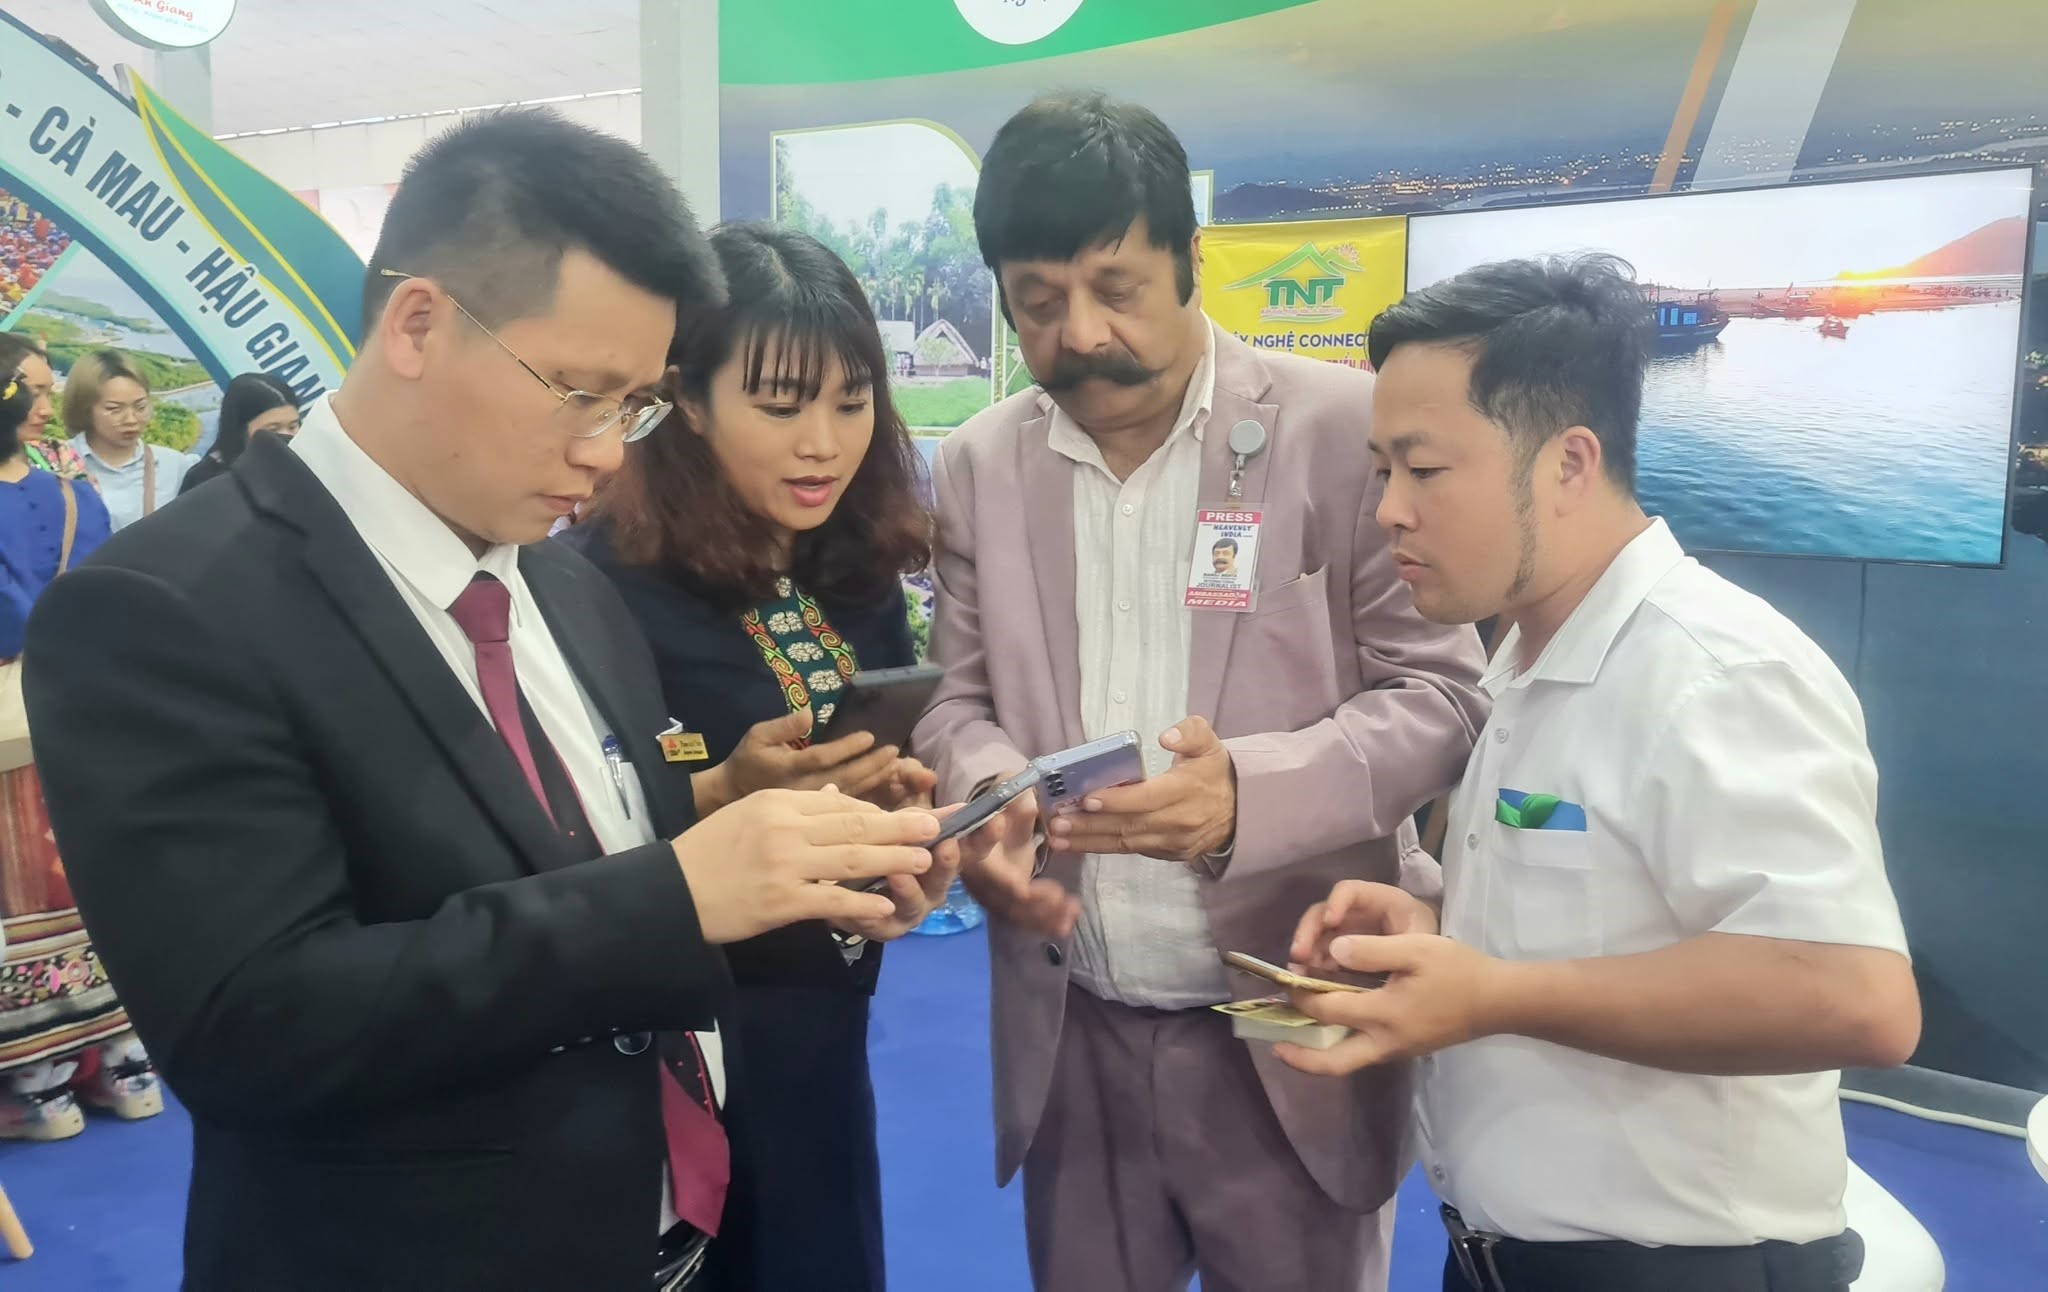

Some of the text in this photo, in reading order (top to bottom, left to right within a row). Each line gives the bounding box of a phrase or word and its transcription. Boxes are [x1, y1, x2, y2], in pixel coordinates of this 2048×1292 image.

[156, 1, 194, 21] Giang
[29, 106, 97, 177] CÀ
[85, 150, 185, 242] MAU
[185, 246, 269, 328] HẬU
[246, 322, 326, 420] GIAN
[1263, 278, 1345, 306] TNT
[1252, 330, 1295, 352] NGHỆ
[1299, 333, 1369, 348] CONNEC
[1206, 512, 1254, 522] PRESS
[1186, 598, 1248, 607] MEDIA
